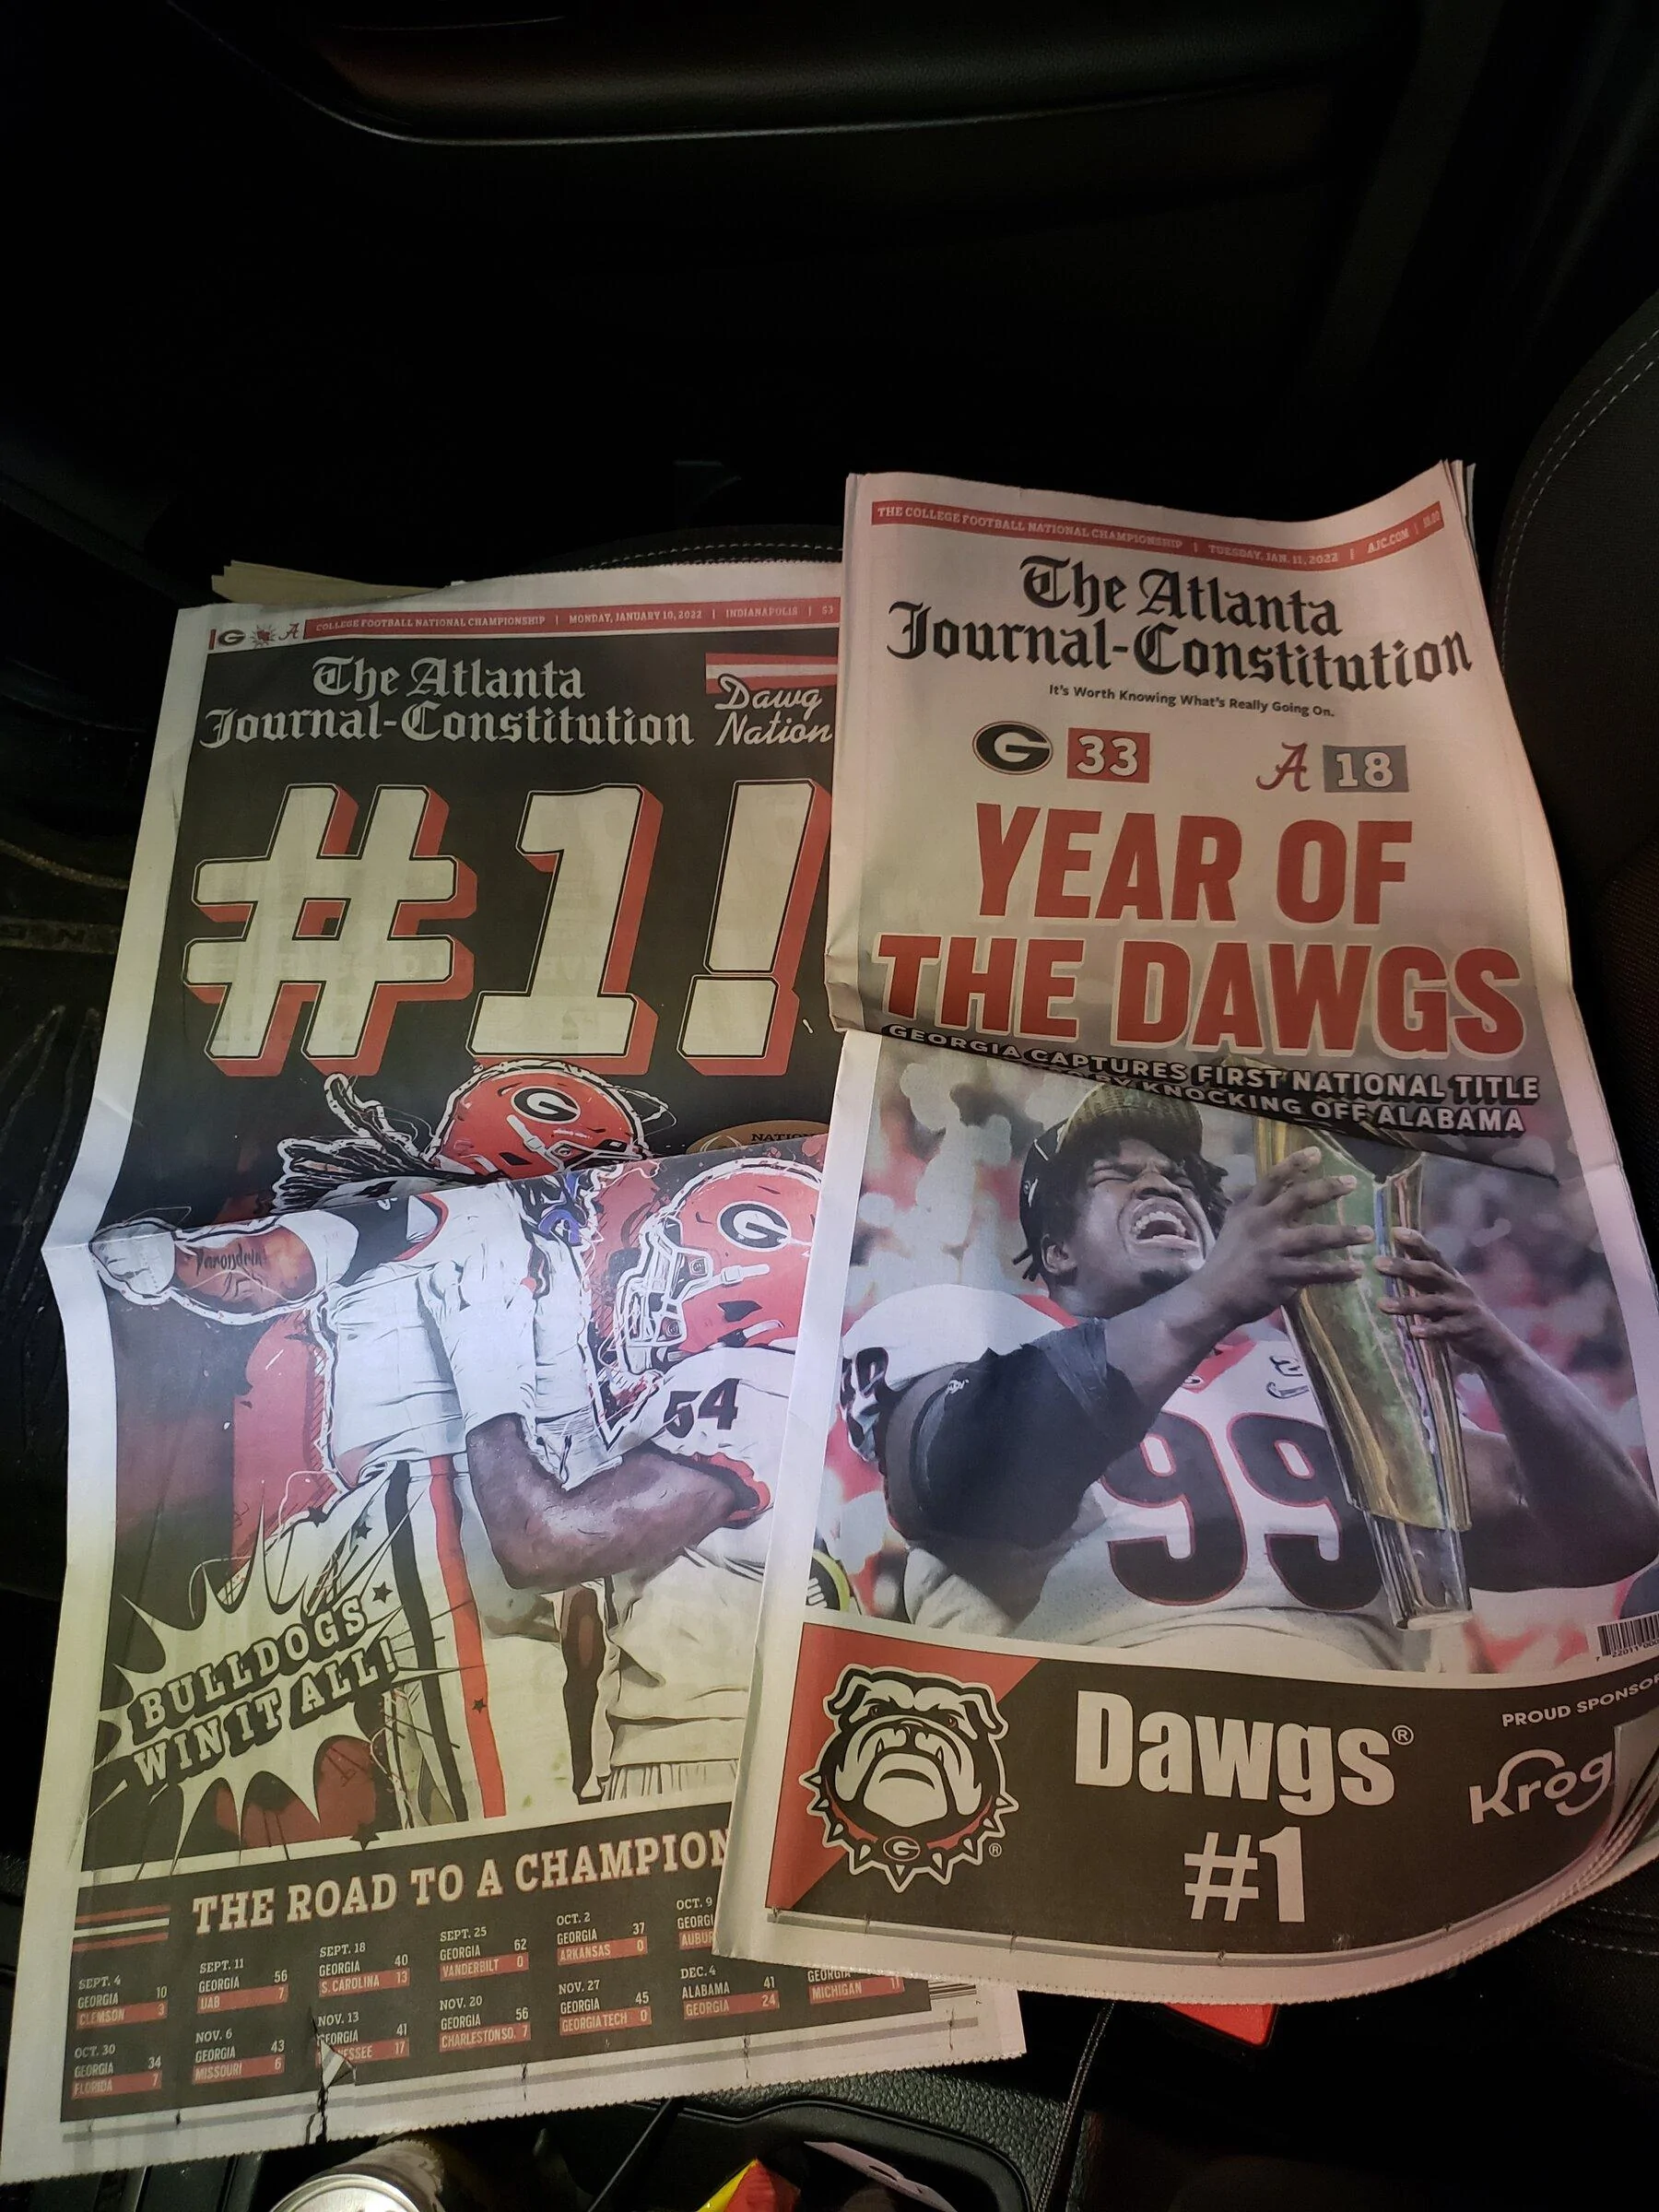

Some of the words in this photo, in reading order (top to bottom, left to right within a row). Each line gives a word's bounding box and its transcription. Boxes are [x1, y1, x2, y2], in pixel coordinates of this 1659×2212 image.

[877, 507, 902, 518] THE
[905, 507, 960, 524] COLLEGE
[961, 514, 1025, 532] FOOTBALL
[1028, 522, 1089, 538] NATIONAL
[1091, 528, 1183, 549] CHAMPIONSHIP
[1367, 527, 1409, 554] AJC.COM
[1208, 544, 1264, 561] TUESDAY,
[1265, 552, 1290, 563] JAN.
[1309, 552, 1338, 564] 2022
[1019, 554, 1127, 618] The
[1137, 567, 1345, 638] Atlanta
[315, 618, 359, 632] COLLEGE
[360, 618, 414, 629] FOOTBALL
[415, 617, 465, 628] NATIONAL
[467, 616, 546, 627] CHAMPIONSHIP
[569, 613, 614, 624] MONDAY,
[615, 611, 660, 622] JANUARY
[663, 611, 677, 622] 10,
[678, 610, 702, 620] 2022
[725, 607, 798, 618] INDIANAPOLIS
[887, 600, 1473, 695] Journal-Constitution
[312, 655, 400, 702] The
[411, 656, 585, 700] Atlanta
[714, 674, 823, 721] Dawg
[1049, 684, 1069, 697] It's
[1073, 686, 1115, 700] Worth
[1119, 688, 1176, 707] Knowing
[1181, 694, 1226, 709] What's
[1230, 698, 1268, 713] Really
[1272, 701, 1310, 718] Going
[1312, 706, 1335, 718] On.
[199, 700, 695, 748] Journal-Constitution
[714, 711, 832, 746] Nation
[1075, 734, 1138, 777] 33
[1334, 750, 1394, 788] 18
[973, 801, 1244, 922] YEAR
[1276, 818, 1414, 925] OF
[182, 779, 831, 1077] #1!
[874, 934, 1086, 1041] THE
[1111, 938, 1526, 1059] DAWGS
[888, 1024, 1022, 1059] GEORGIA
[1030, 1049, 1188, 1082] CAPTURES
[1198, 1065, 1282, 1090] FIRST
[1292, 1070, 1447, 1099] NATIONAL
[1454, 1075, 1539, 1100] TITLE
[1143, 1081, 1303, 1116] KNOCKING
[1315, 1100, 1369, 1124] OFF
[1378, 1106, 1525, 1133] ALABAMA
[664, 1378, 741, 1439] 54
[1102, 1410, 1386, 1612] 99
[138, 1596, 369, 1730] BULLDOGS
[135, 1719, 225, 1787] WIN
[235, 1688, 281, 1742] IT
[300, 1637, 398, 1713] ALL!
[1501, 1705, 1571, 1728] PROUD
[1469, 1748, 1613, 1825] Krog
[192, 1888, 275, 1936] THE
[286, 1872, 398, 1924] ROAD
[410, 1863, 465, 1906] TO
[477, 1858, 504, 1899] A
[514, 1829, 729, 1893] CHAMPION
[1183, 1826, 1306, 1924] #1
[677, 1897, 702, 1911] OCT.
[705, 1897, 712, 1907] 9
[557, 1913, 582, 1926] OCT.
[584, 1912, 591, 1923] 2
[440, 1928, 471, 1942] SEPT.
[474, 1926, 487, 1938] 25
[557, 1928, 597, 1946] GEORGIA
[632, 1922, 645, 1936] 37
[319, 1944, 351, 1958] SEPT.
[354, 1942, 366, 1954] 18
[440, 1945, 481, 1961] GEORGIA
[513, 1938, 527, 1951] 62
[559, 1944, 611, 1961] ARKANSAS
[637, 1939, 643, 1952] 0
[199, 1959, 231, 1974] SEPT.
[234, 1958, 244, 1969] 11
[319, 1959, 360, 1977] GEORGIA
[394, 1953, 408, 1967] 40
[442, 1959, 500, 1978] VANDERBILT
[516, 1955, 524, 1968] 0
[680, 1966, 708, 1979] DEC.
[709, 1965, 717, 1976] 4
[78, 1976, 111, 1990] SEPT.
[113, 1975, 121, 1985] 4
[198, 1976, 240, 1993] GEORGIA
[274, 1970, 288, 1983] 56
[321, 1981, 331, 1994] S.
[332, 1974, 380, 1993] CAROLINA
[396, 1971, 407, 1984] 13
[559, 1982, 584, 1995] NOV.
[587, 1979, 600, 1991] 27
[682, 1982, 730, 1999] ALABAMA
[763, 1976, 775, 1989] 41
[812, 1982, 863, 2001] MICHIGAN
[77, 1992, 118, 2009] GEORGIA
[156, 1985, 167, 1999] 10
[200, 1995, 220, 2009] UAB
[278, 1987, 285, 2000] 7
[439, 1996, 466, 2011] NOV.
[469, 1995, 483, 2007] 20
[560, 1997, 600, 2015] GEORGIA
[635, 1991, 649, 2005] 45
[686, 1999, 730, 2017] GEORGIA
[761, 1994, 776, 2007] 24
[79, 2008, 125, 2026] CLEMSON
[317, 2012, 345, 2027] NOV.
[347, 2011, 359, 2023] 13
[441, 2013, 481, 2030] GEORGIA
[515, 2007, 529, 2021] 56
[562, 2015, 602, 2032] GEORGIA
[602, 2012, 628, 2027] TECH
[640, 2009, 647, 2022] 0
[194, 2030, 223, 2044] NOV.
[225, 2028, 233, 2039] 6
[396, 2023, 407, 2036] 41
[441, 2029, 501, 2048] CHARLESTON
[522, 2025, 528, 2039] 7
[74, 2045, 99, 2059] OCT.
[102, 2043, 116, 2055] 30
[194, 2045, 236, 2064] GEORGIA
[270, 2039, 285, 2053] 43
[395, 2041, 406, 2054] 17
[74, 2062, 114, 2077] GEORGIA
[147, 2055, 161, 2069] 34
[194, 2061, 242, 2081] MISSOURI
[274, 2057, 282, 2070] 6
[75, 2078, 112, 2096] FLORIDA
[152, 2073, 159, 2087] 7
